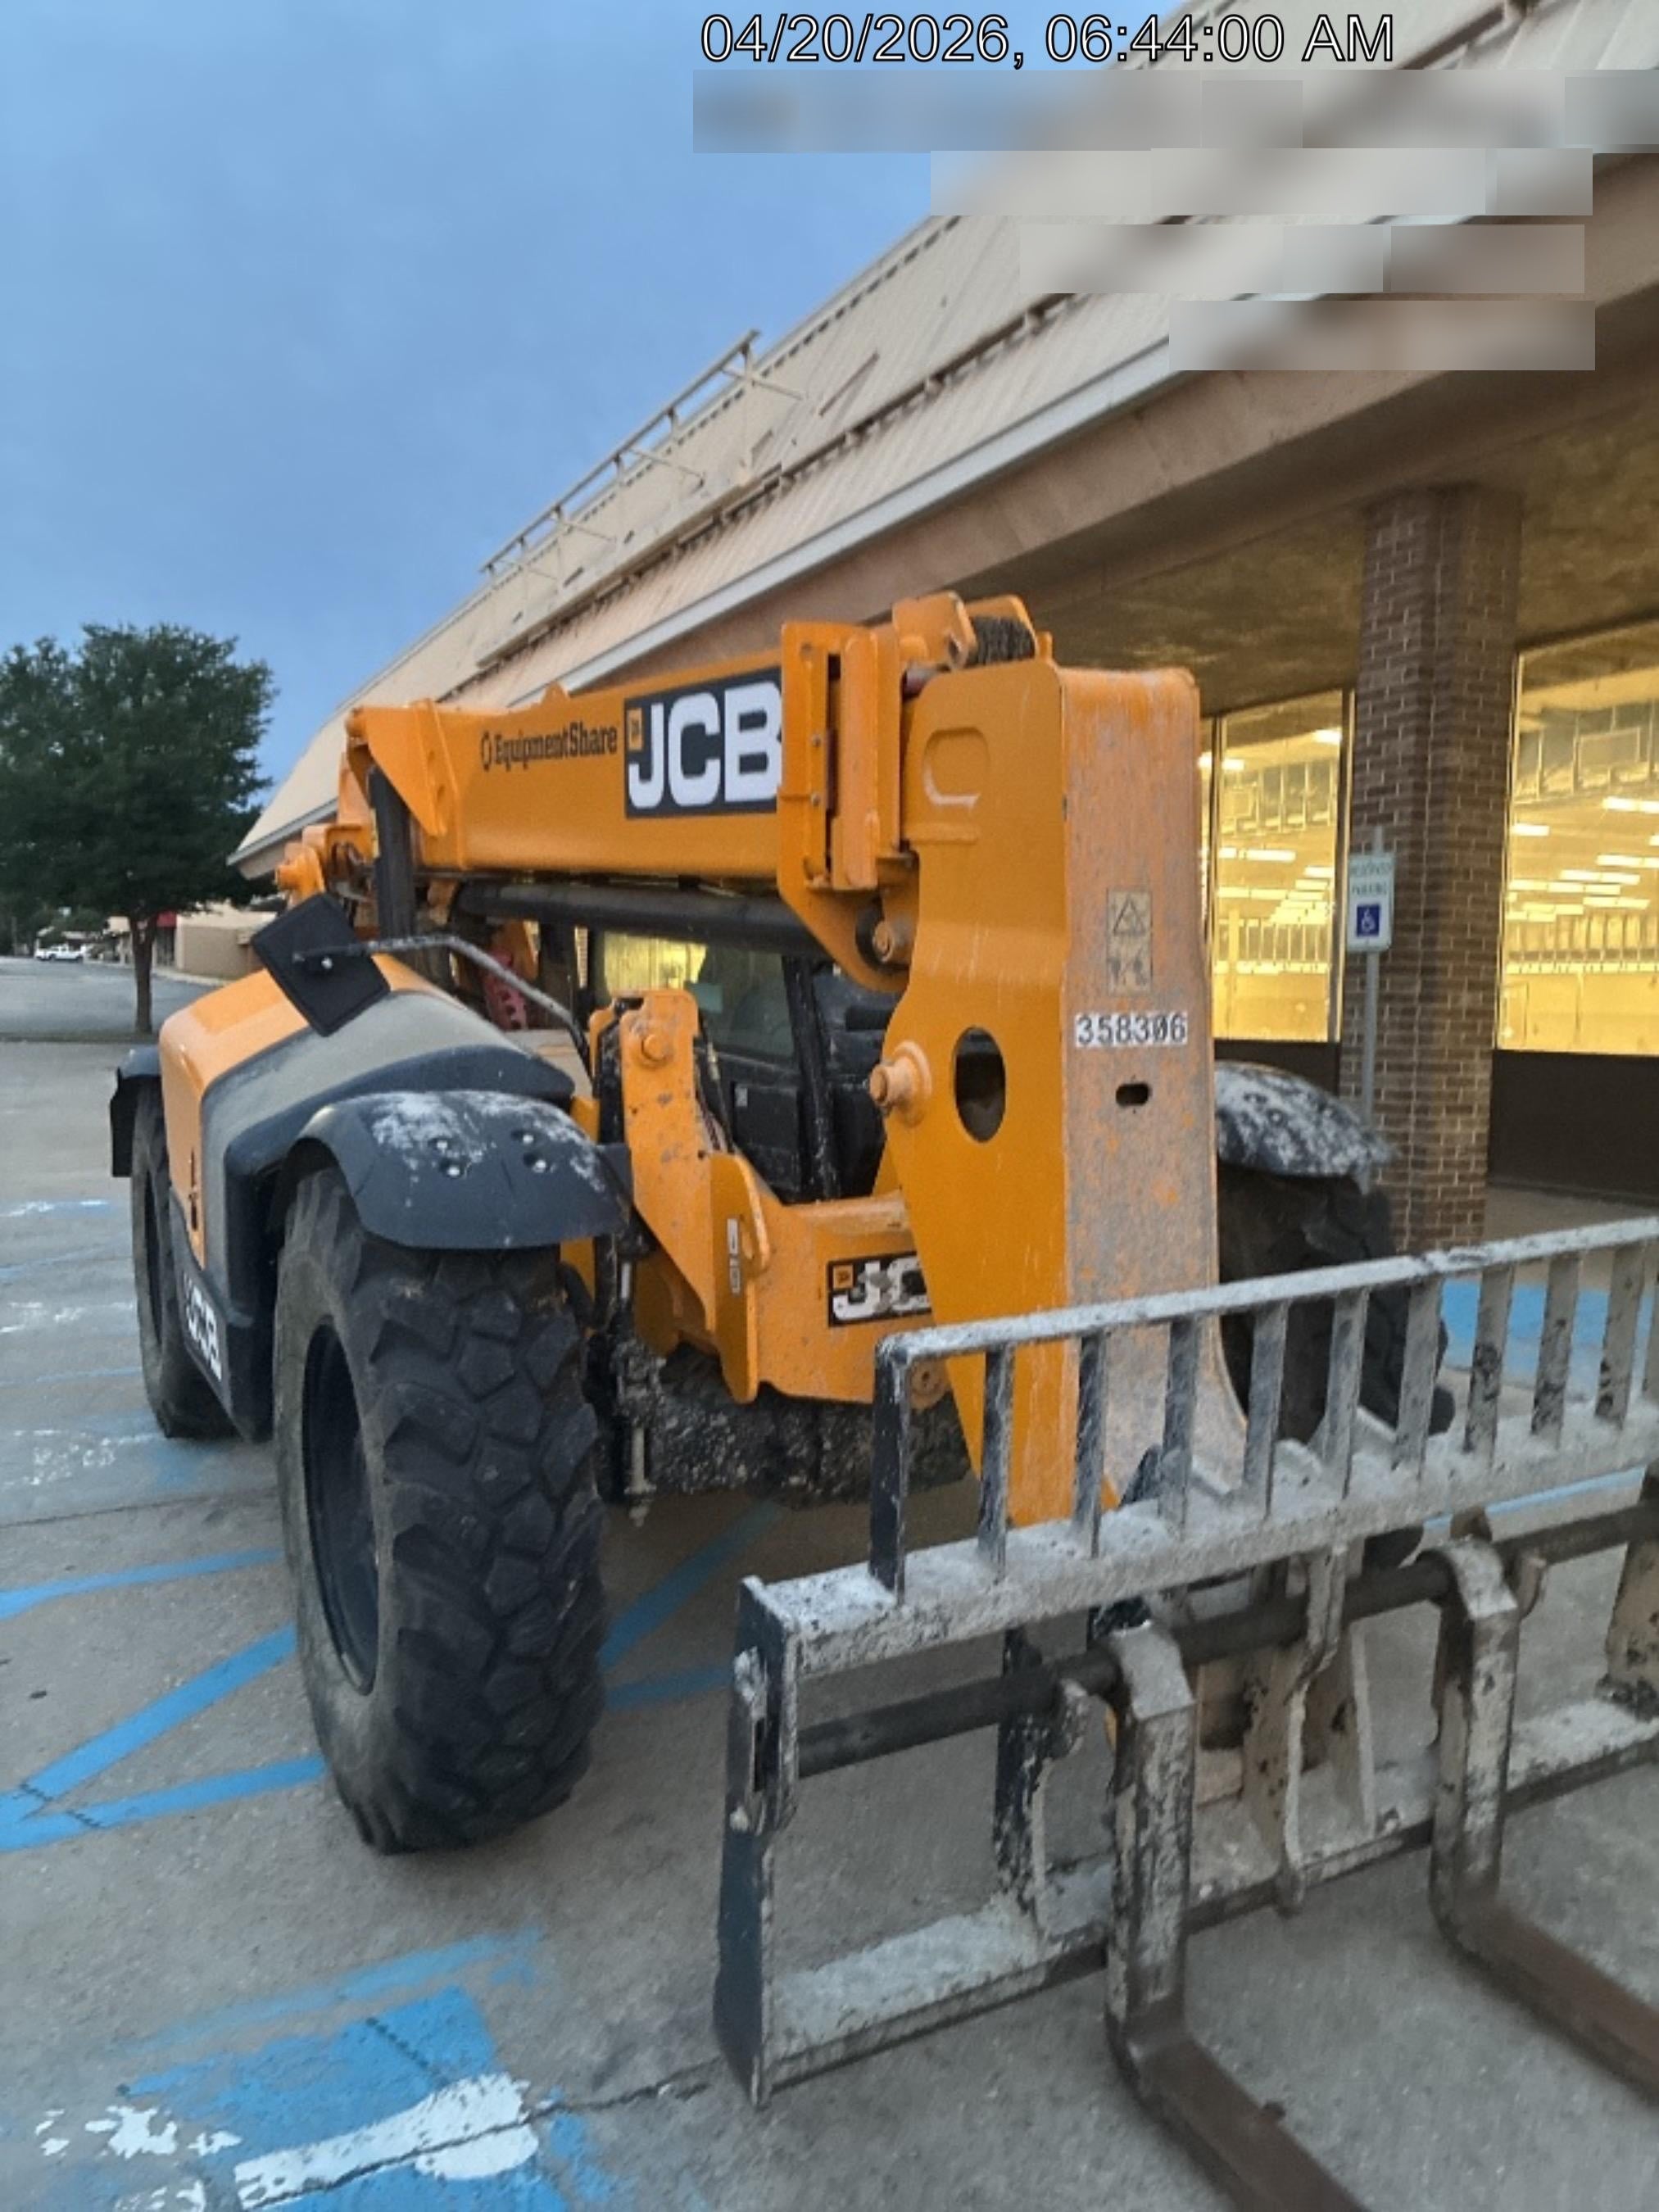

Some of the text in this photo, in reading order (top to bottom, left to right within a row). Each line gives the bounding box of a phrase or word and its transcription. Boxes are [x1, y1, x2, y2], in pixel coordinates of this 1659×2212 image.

[494, 722, 617, 772] EquipmentShare
[628, 681, 782, 809] JCB
[1077, 1014, 1186, 1045] 358306
